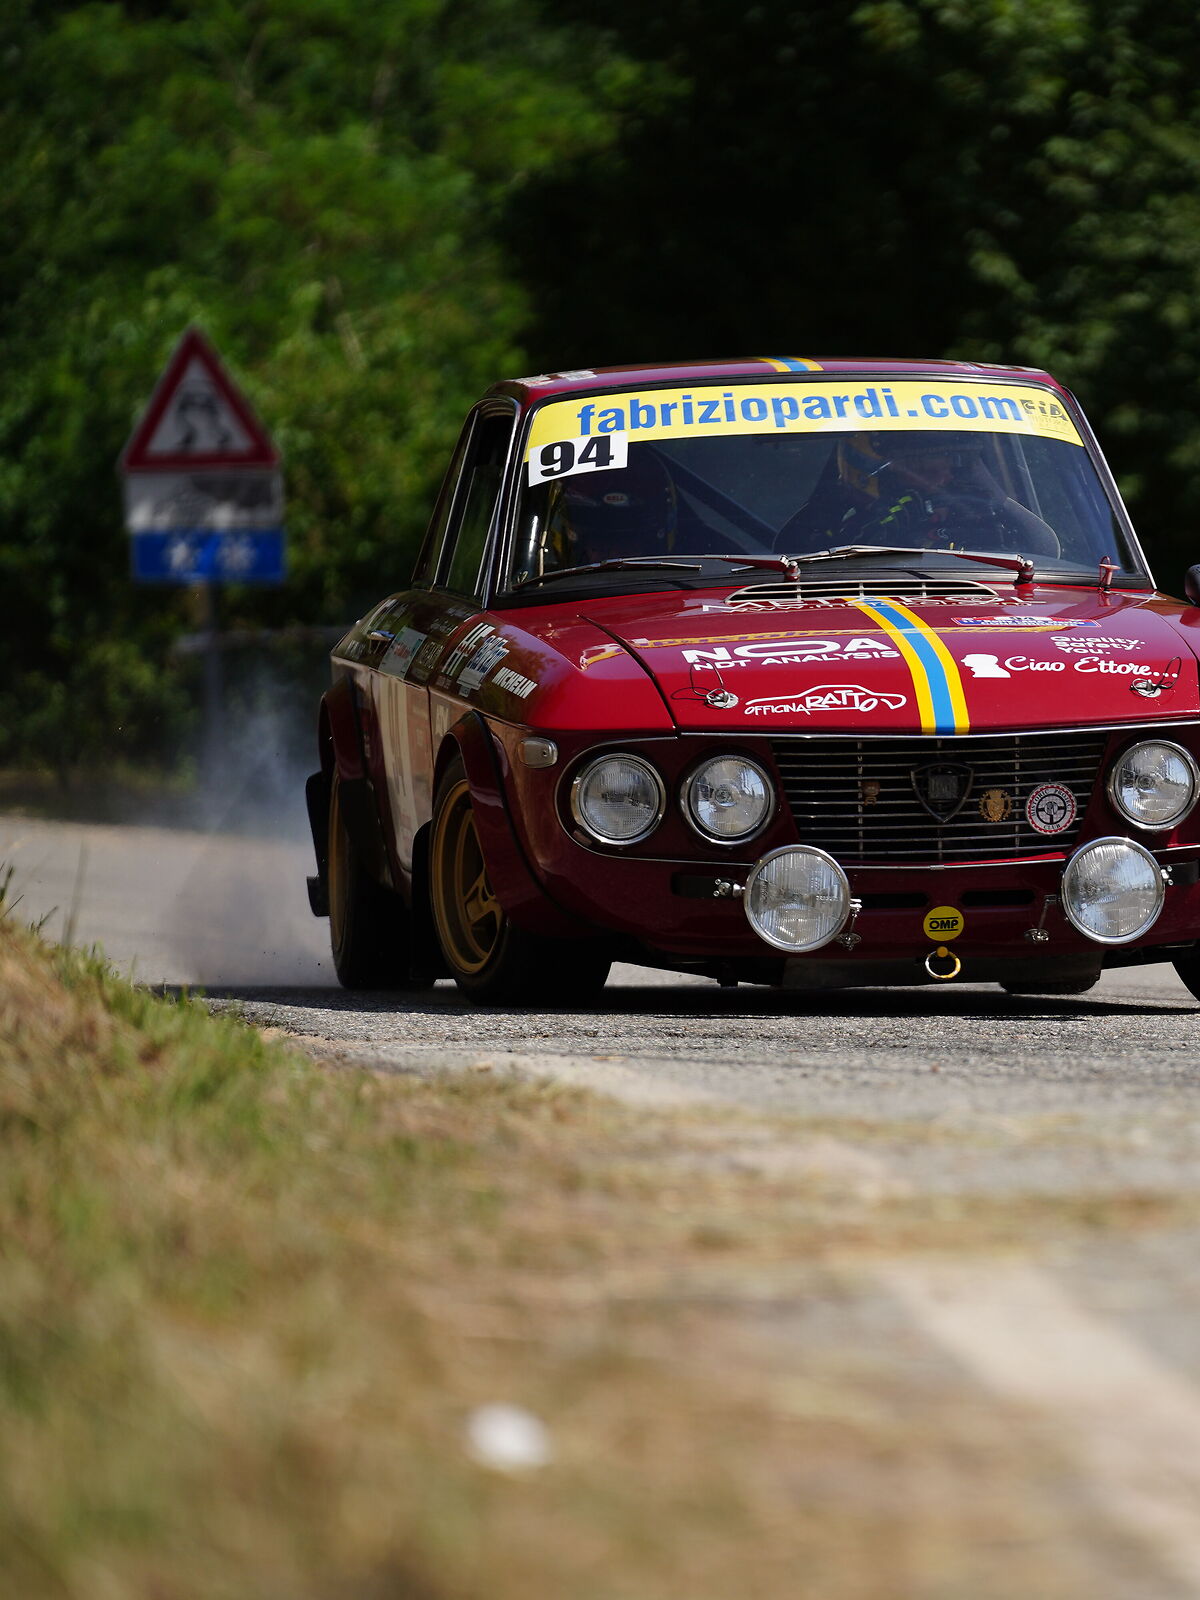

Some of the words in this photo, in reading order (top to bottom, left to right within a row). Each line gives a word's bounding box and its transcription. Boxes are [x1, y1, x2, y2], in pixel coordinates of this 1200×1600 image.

[576, 387, 1024, 435] fabriziopardi.com
[539, 435, 615, 478] 94
[1050, 636, 1146, 645] Quality.
[1054, 642, 1142, 650] Safety.
[681, 638, 892, 664] NOA
[1056, 646, 1111, 655] You.
[694, 660, 750, 671] NDT
[761, 650, 900, 665] ANALYSIS
[1004, 655, 1065, 672] Ciao
[492, 667, 538, 699] MICHELIN
[744, 701, 811, 715] OFFICINA
[806, 690, 878, 713] RATTO
[929, 919, 959, 930] OMP
